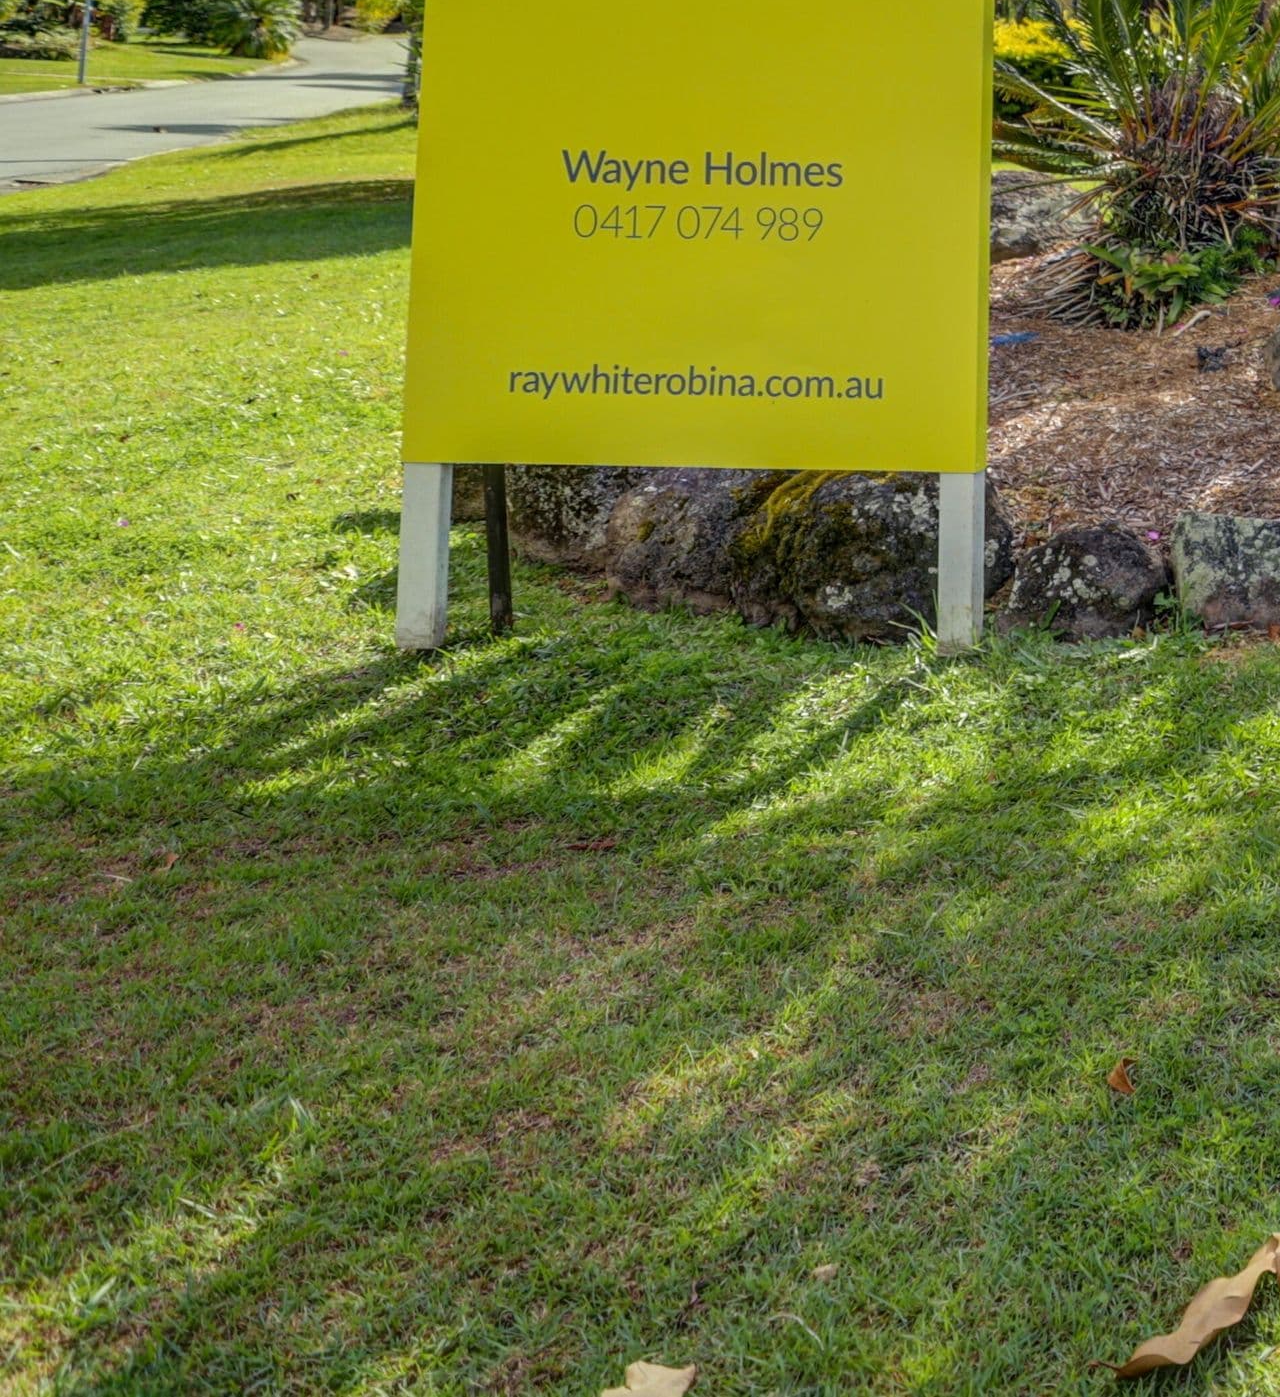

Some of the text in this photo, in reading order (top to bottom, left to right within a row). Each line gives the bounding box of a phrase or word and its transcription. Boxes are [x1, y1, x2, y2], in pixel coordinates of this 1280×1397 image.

[561, 149, 843, 191] Wayne Holmes
[574, 204, 824, 241] 0417 074 989
[509, 364, 883, 400] raywhiterobina.com.au
